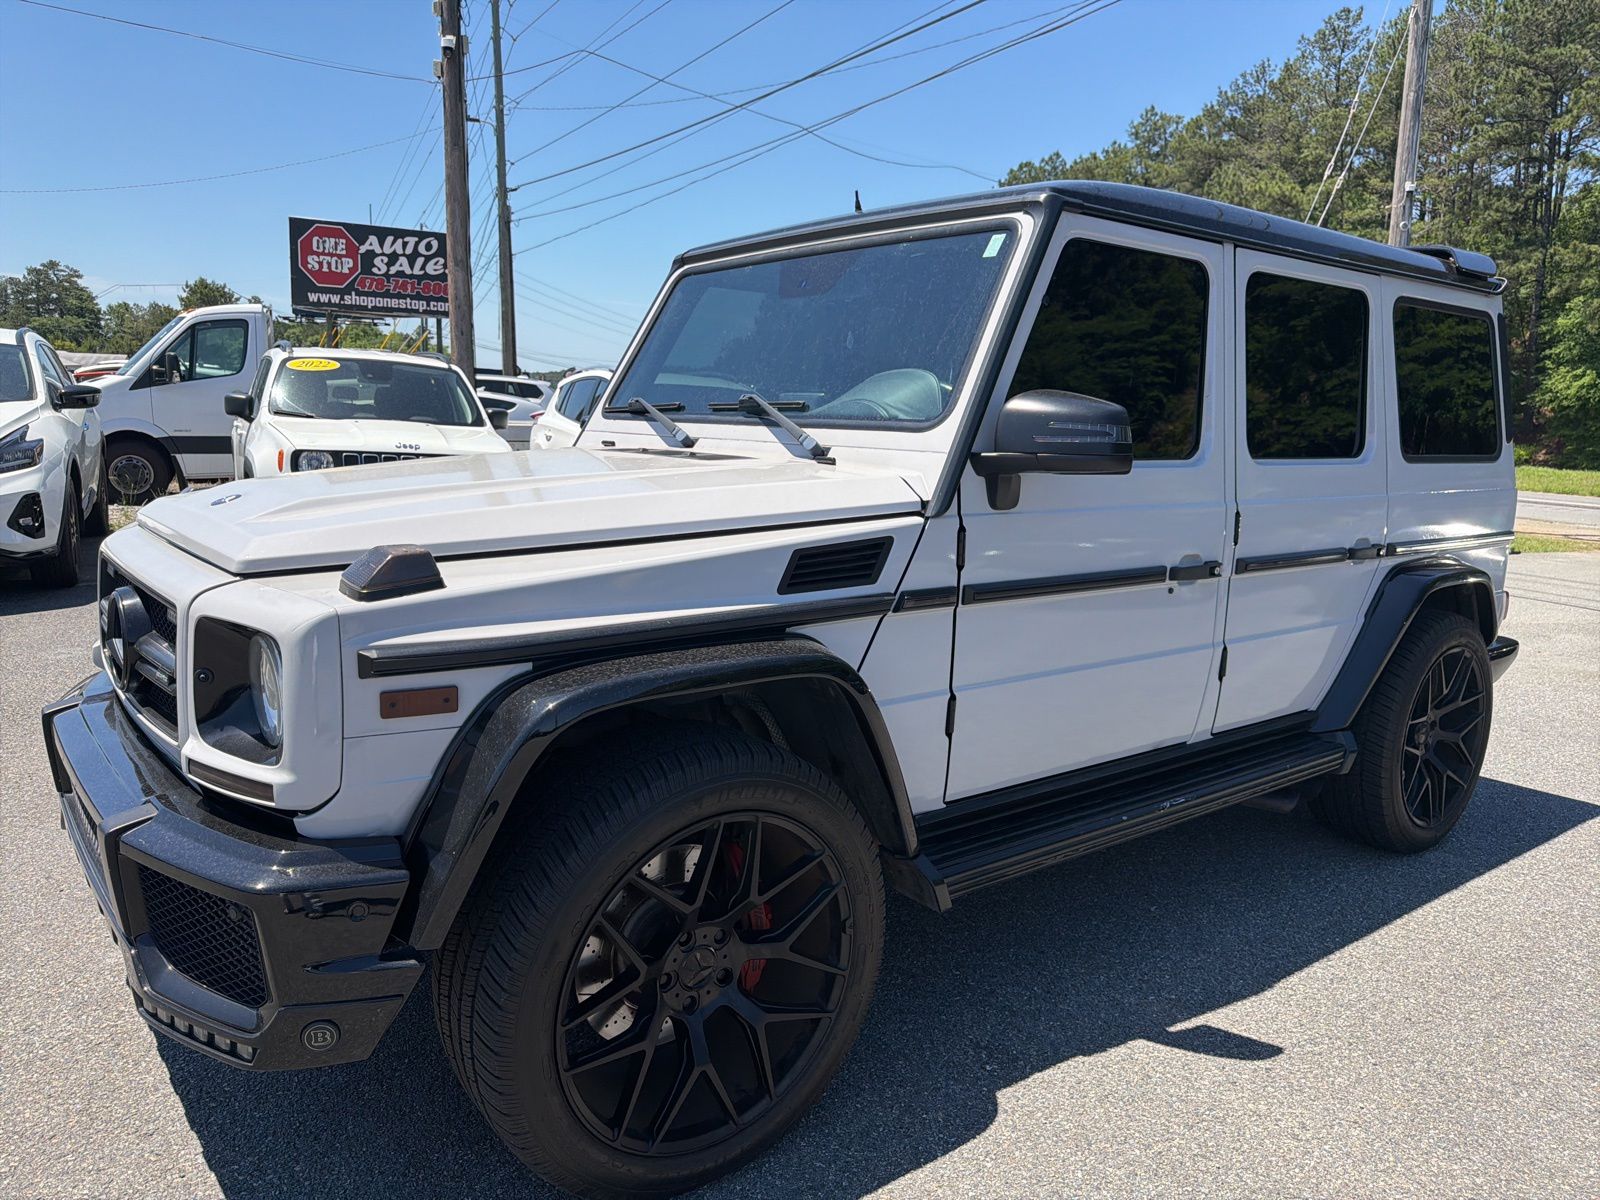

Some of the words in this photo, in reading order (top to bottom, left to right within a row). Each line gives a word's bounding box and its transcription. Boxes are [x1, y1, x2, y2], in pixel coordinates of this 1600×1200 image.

[312, 236, 347, 255] ONE
[358, 235, 439, 256] AUTO
[307, 255, 354, 274] STOP
[371, 256, 449, 276] SALE
[355, 274, 448, 298] 478-741-808
[295, 360, 331, 368] 2022
[394, 441, 421, 451] Jeep
